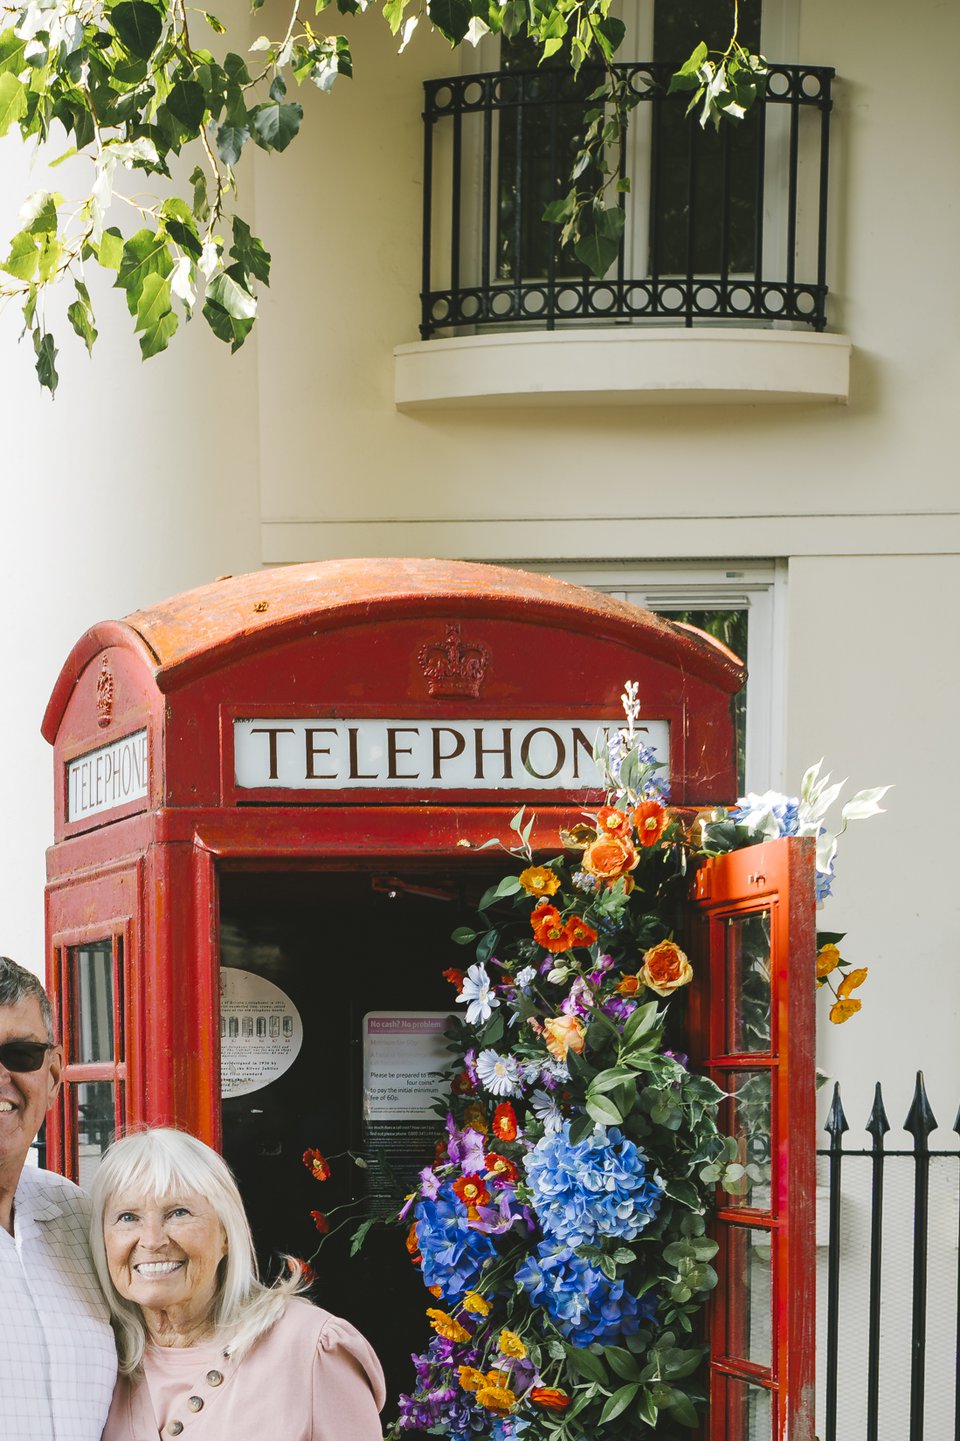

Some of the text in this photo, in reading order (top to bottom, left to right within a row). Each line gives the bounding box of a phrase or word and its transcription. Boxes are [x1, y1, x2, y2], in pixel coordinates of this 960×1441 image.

[250, 727, 649, 780] TELEPHON
[72, 738, 147, 814] TELEPHONE
[412, 1021, 441, 1029] problem
[396, 1072, 420, 1080] prepared
